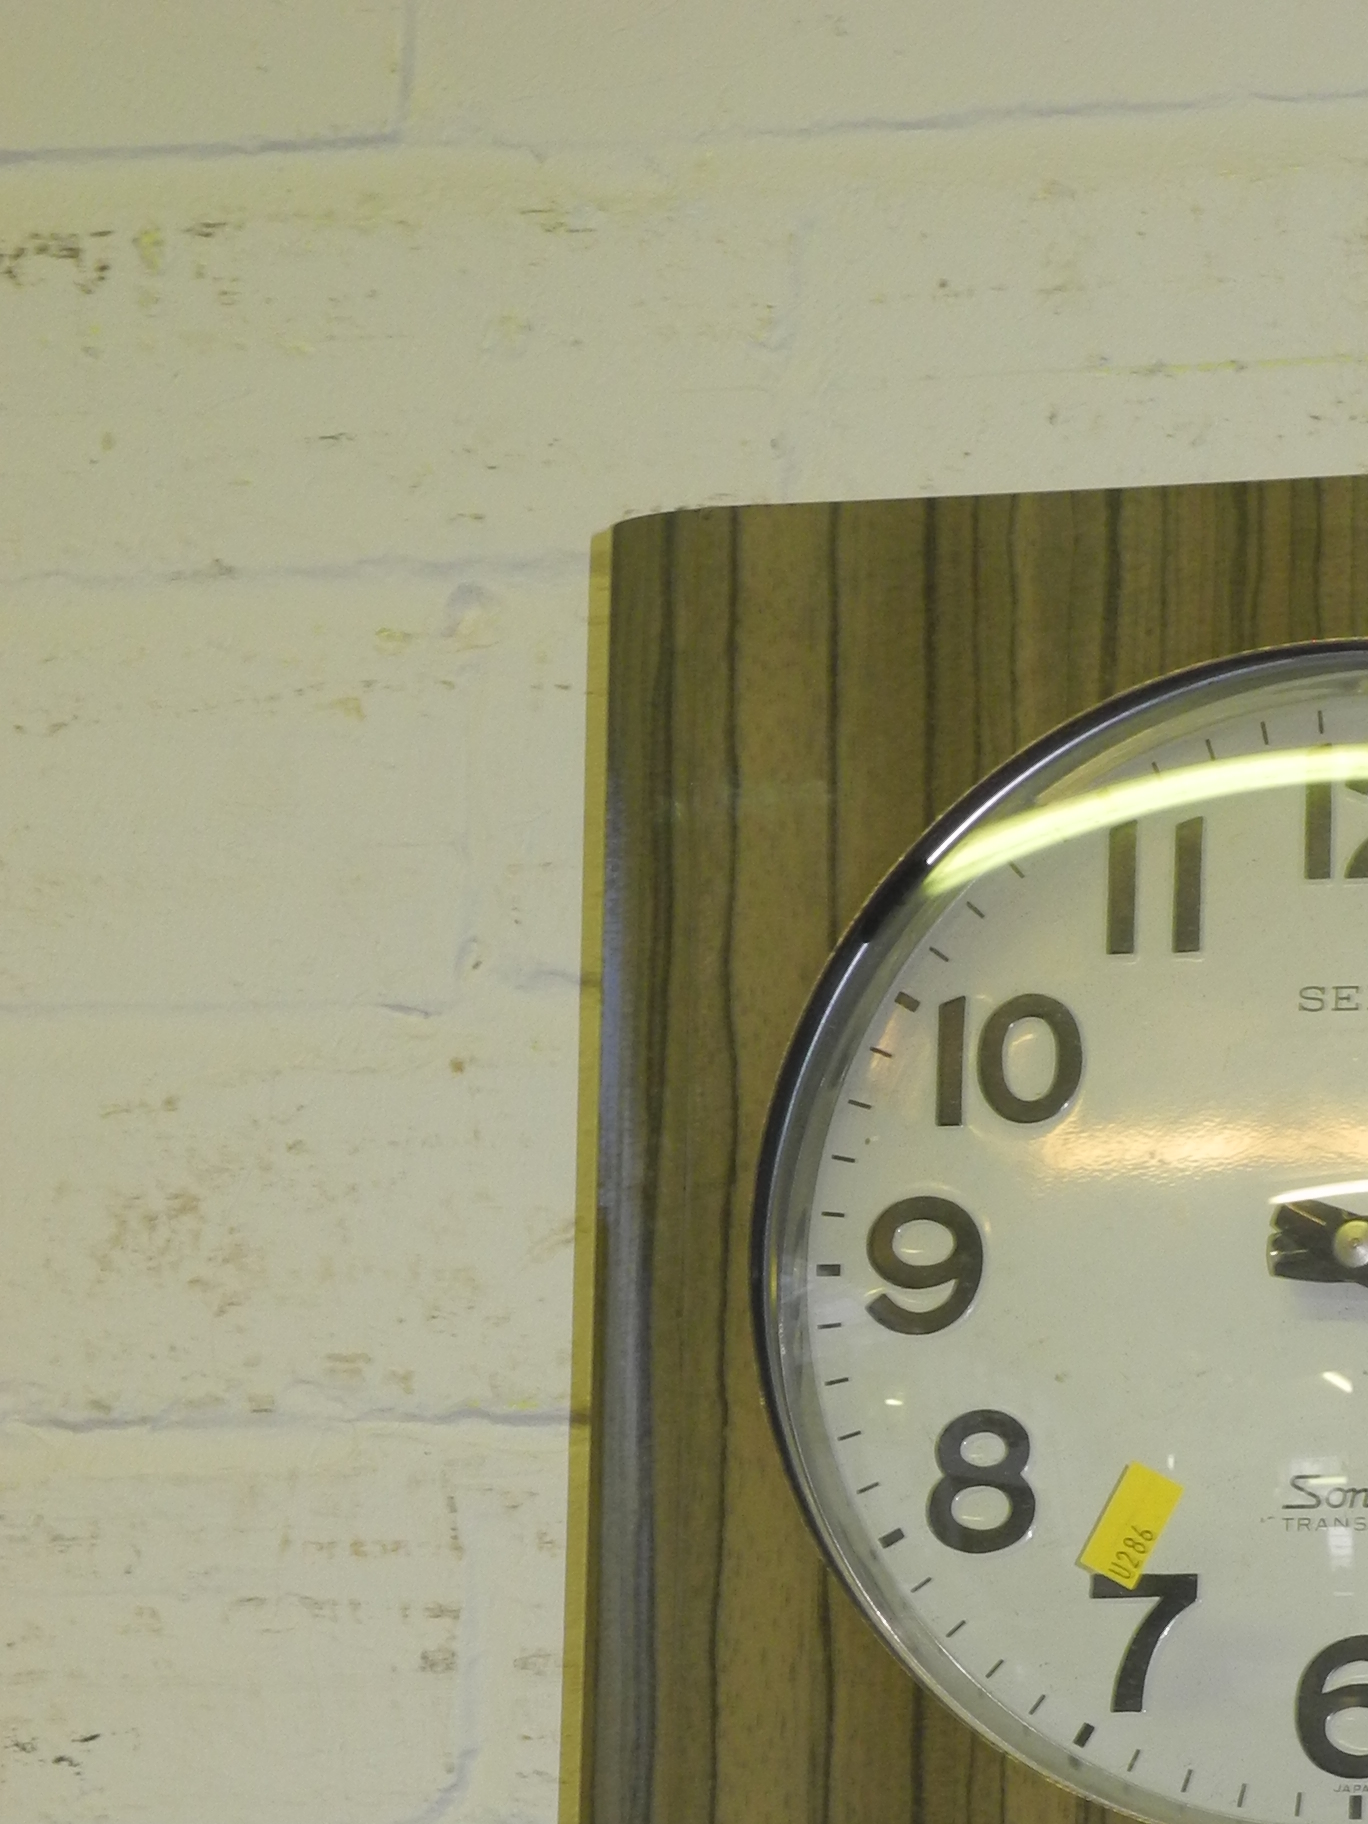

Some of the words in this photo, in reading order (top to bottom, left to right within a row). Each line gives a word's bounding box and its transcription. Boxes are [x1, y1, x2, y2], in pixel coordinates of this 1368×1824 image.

[1107, 816, 1204, 955] 11
[935, 993, 1083, 1126] 10
[865, 1195, 984, 1335] 9
[926, 1409, 1036, 1554] 8
[1090, 1573, 1198, 1712] 7
